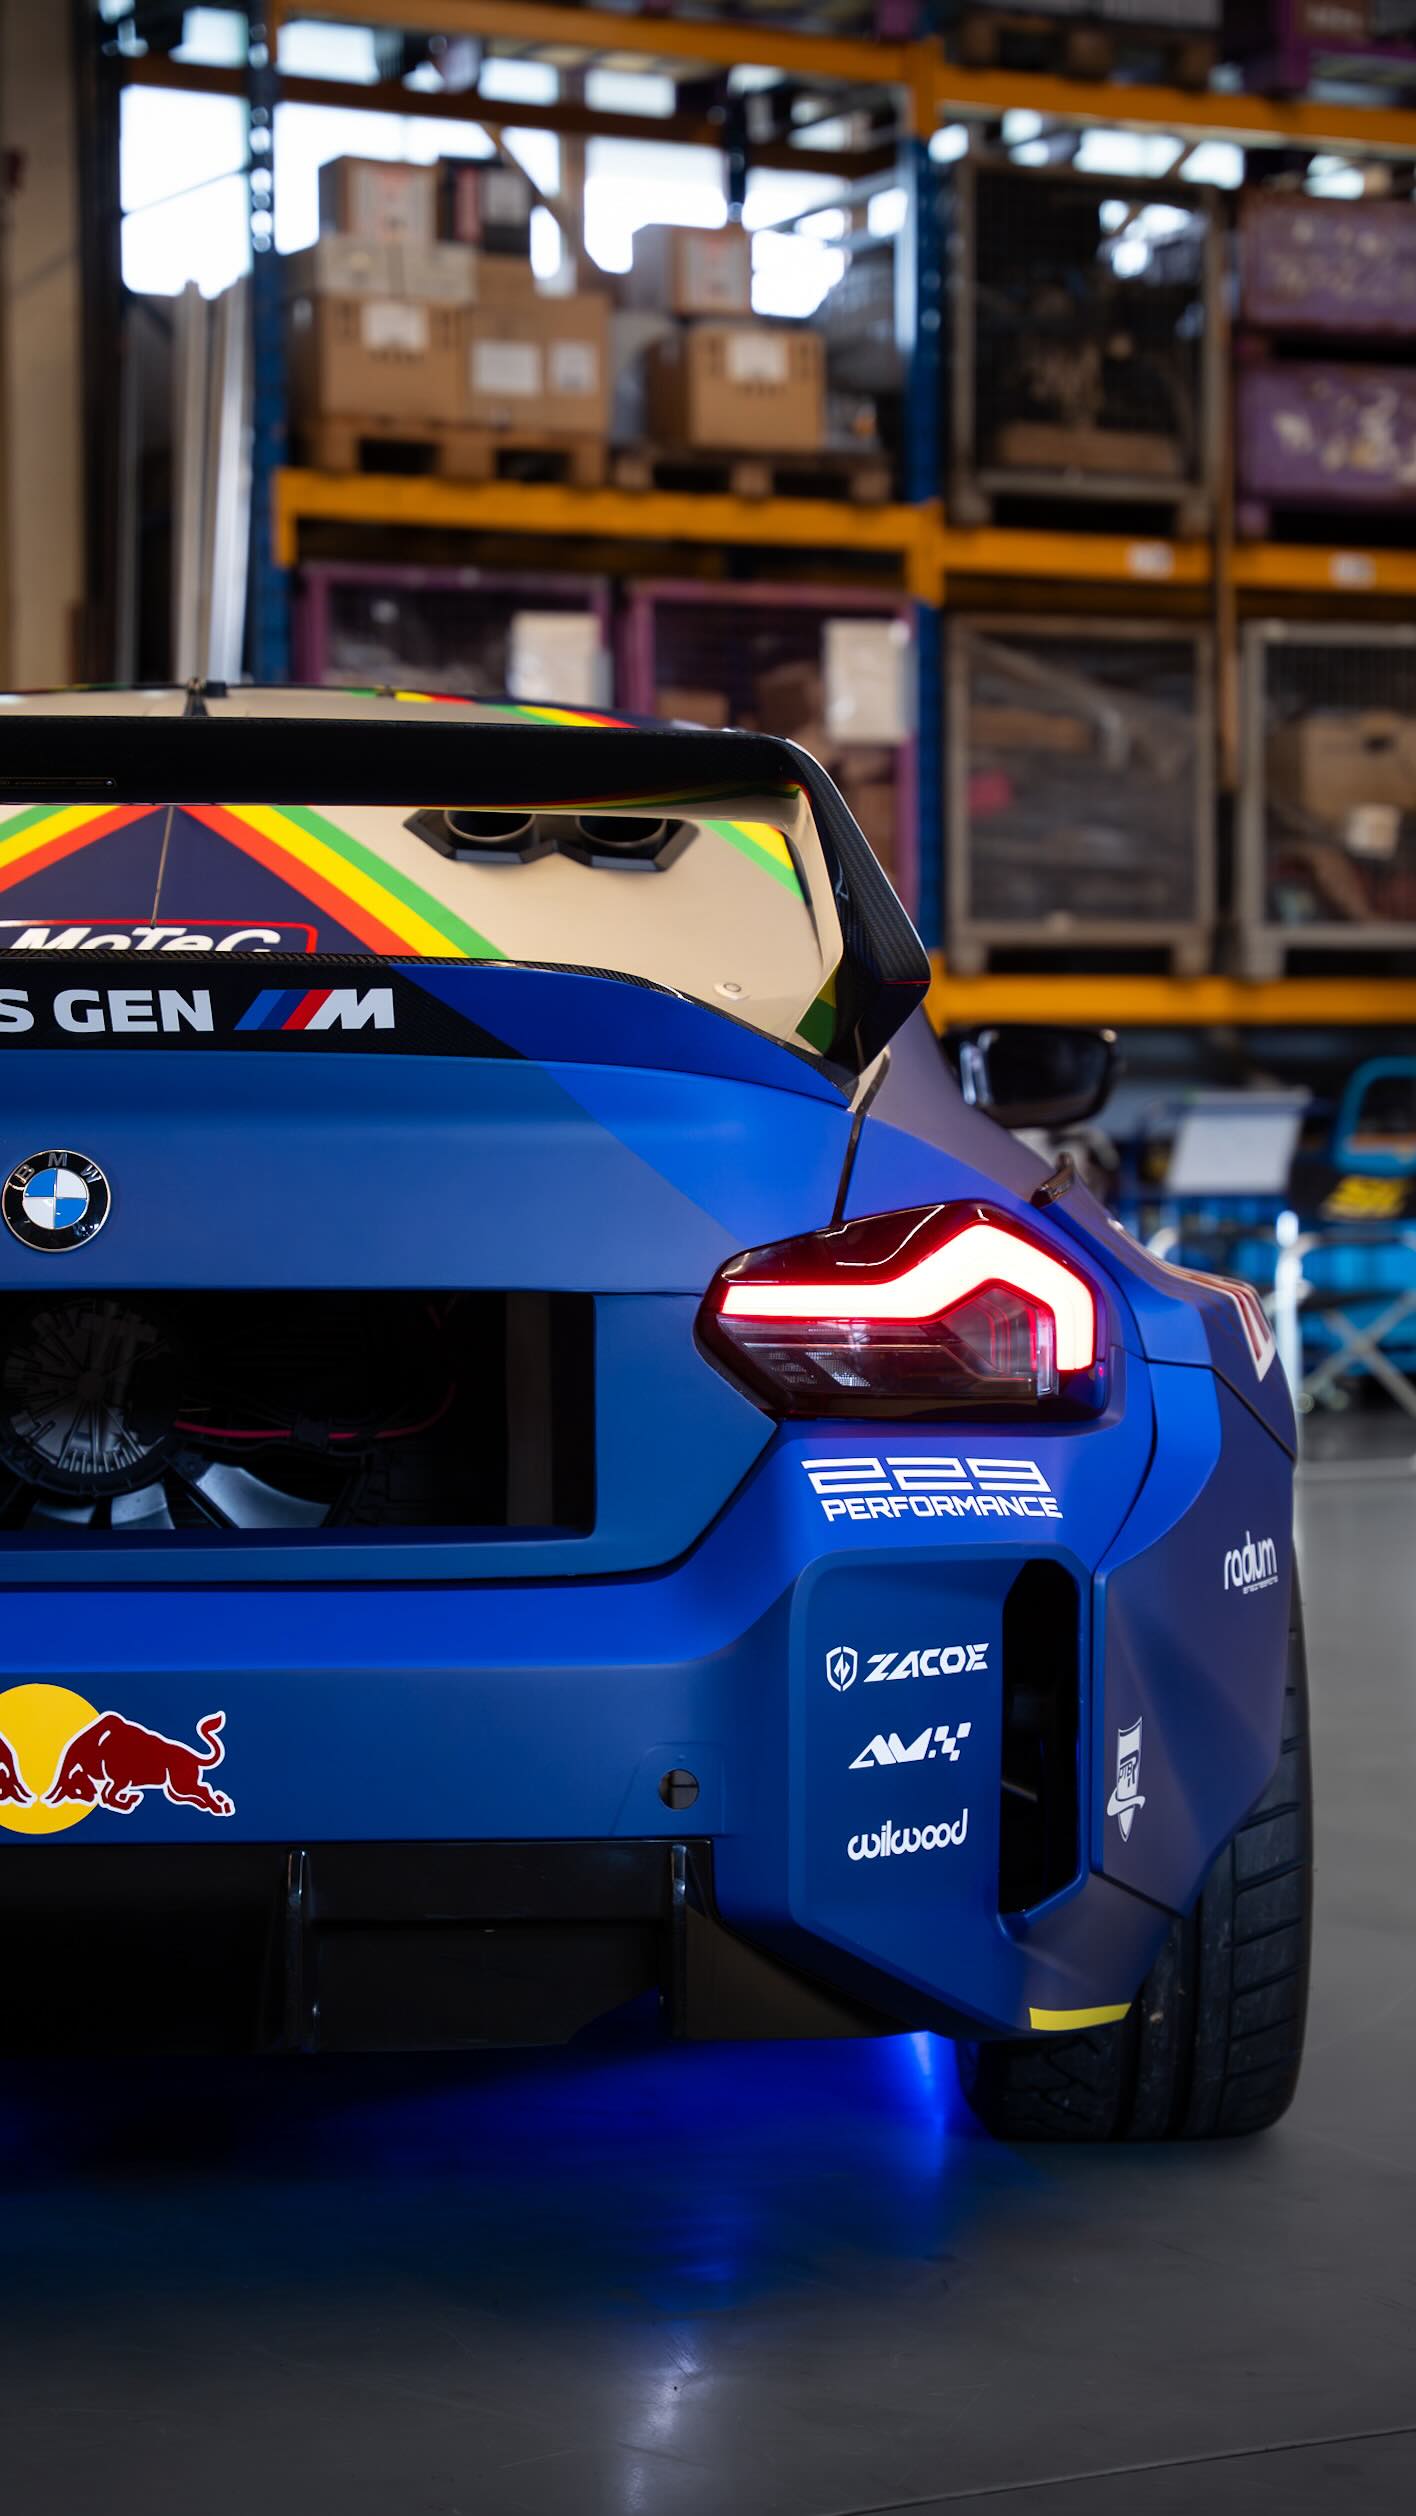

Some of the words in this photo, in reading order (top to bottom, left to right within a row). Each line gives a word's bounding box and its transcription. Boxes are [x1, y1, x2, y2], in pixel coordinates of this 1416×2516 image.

[53, 988, 214, 1033] GEN
[14, 1152, 102, 1184] BMW
[801, 1457, 1051, 1494] 229
[820, 1495, 1063, 1522] PERFORMANCE
[1224, 1530, 1278, 1590] radium
[864, 1643, 989, 1683] ZACOE
[847, 1808, 968, 1861] wilwood
